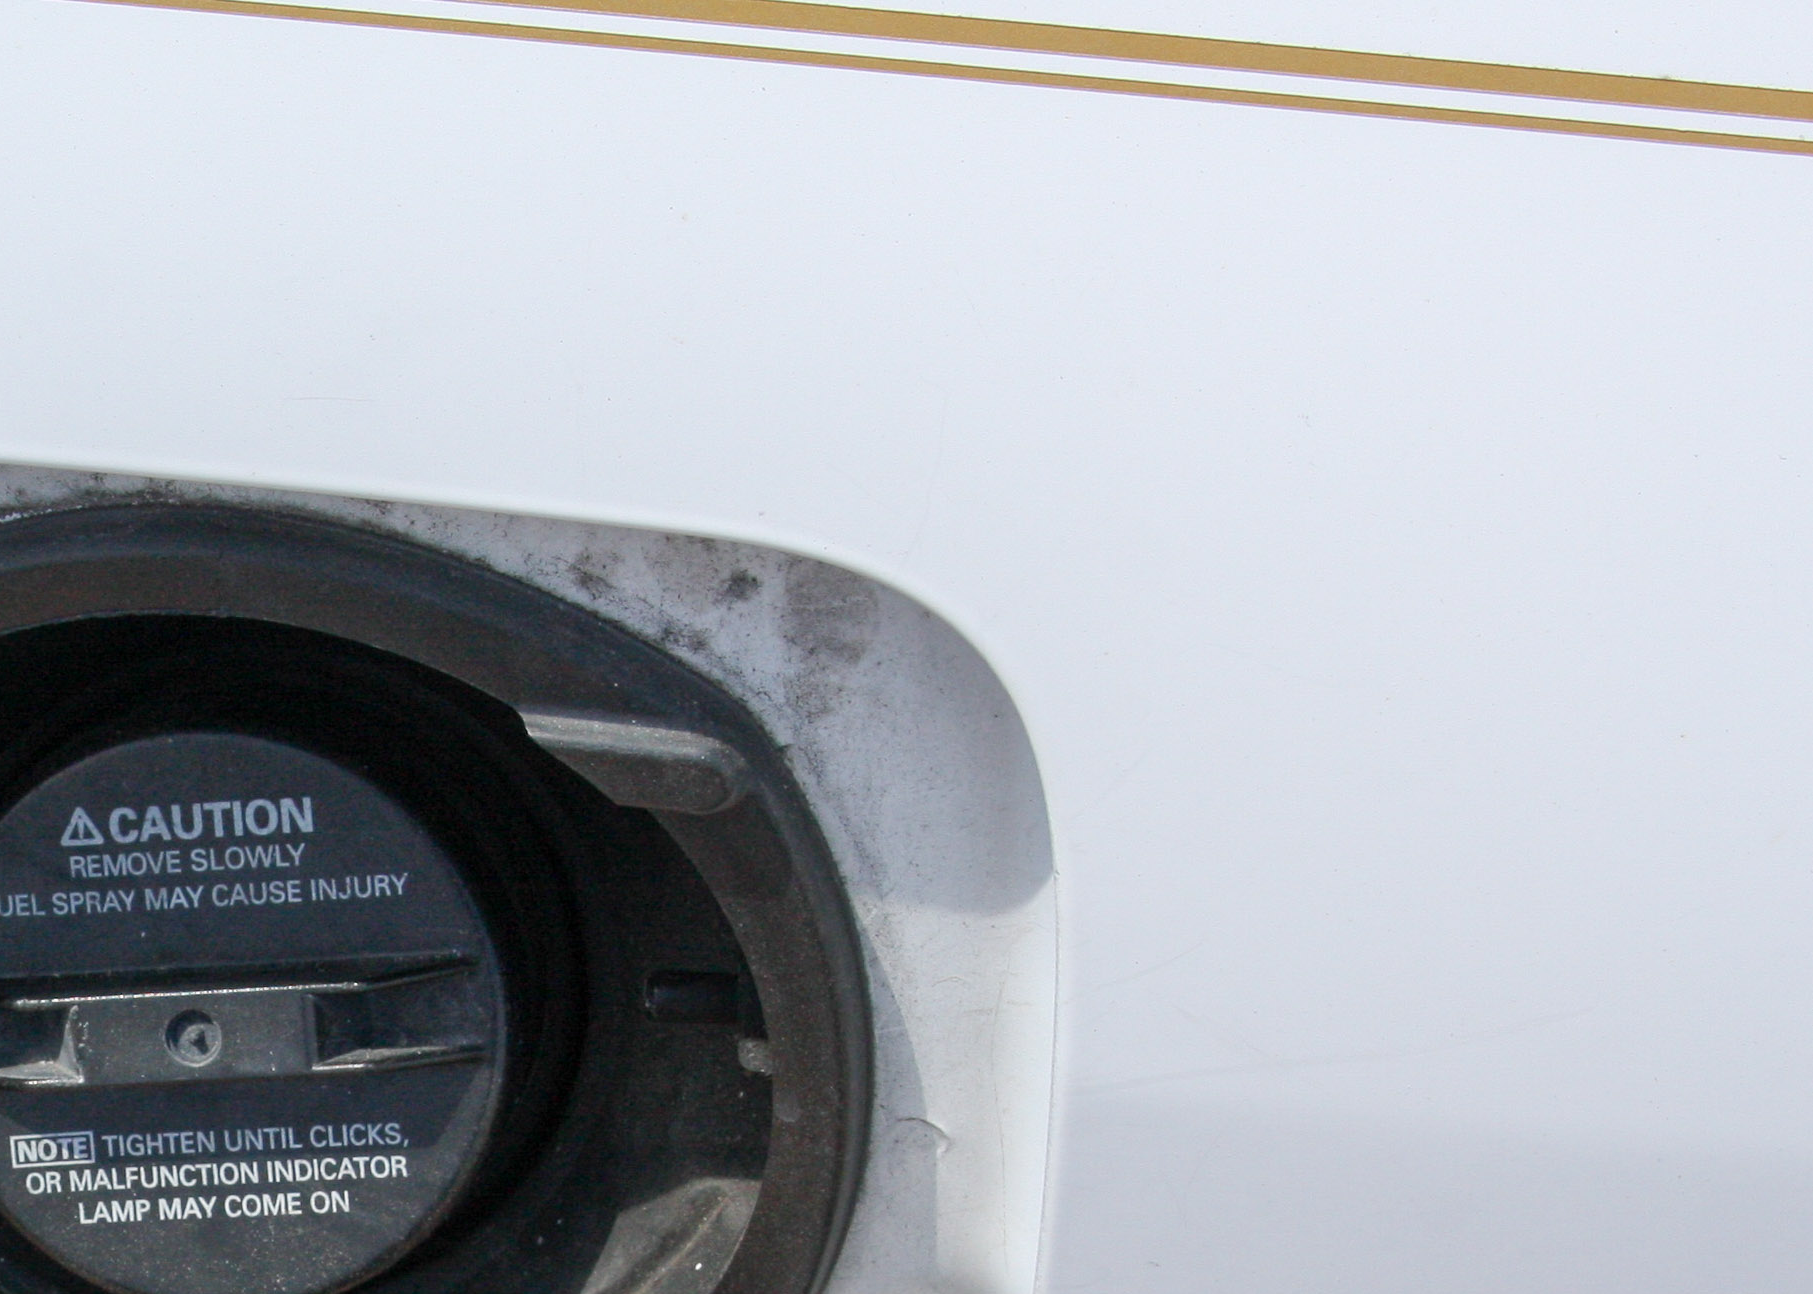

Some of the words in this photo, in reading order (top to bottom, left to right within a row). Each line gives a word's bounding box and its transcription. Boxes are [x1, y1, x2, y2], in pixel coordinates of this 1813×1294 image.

[108, 798, 313, 843] CAUTION
[69, 850, 182, 878] REMOVE
[191, 843, 305, 871] SLOWLY
[52, 889, 136, 915] SPRAY
[145, 886, 204, 911] MAY
[212, 881, 302, 907] CAUSE
[310, 872, 408, 901] INJURY
[17, 1138, 88, 1162] NOTE
[102, 1130, 215, 1157] TIGHTEN
[224, 1127, 302, 1152] UNTIL
[310, 1123, 409, 1149] CLICKS,
[26, 1171, 62, 1194] OR
[69, 1161, 261, 1192] MALFUNCTION
[267, 1155, 407, 1182] INDICATOR
[78, 1199, 151, 1224] LAMP
[159, 1196, 217, 1220] MAY
[225, 1192, 302, 1218] COME
[310, 1191, 350, 1214] ON
